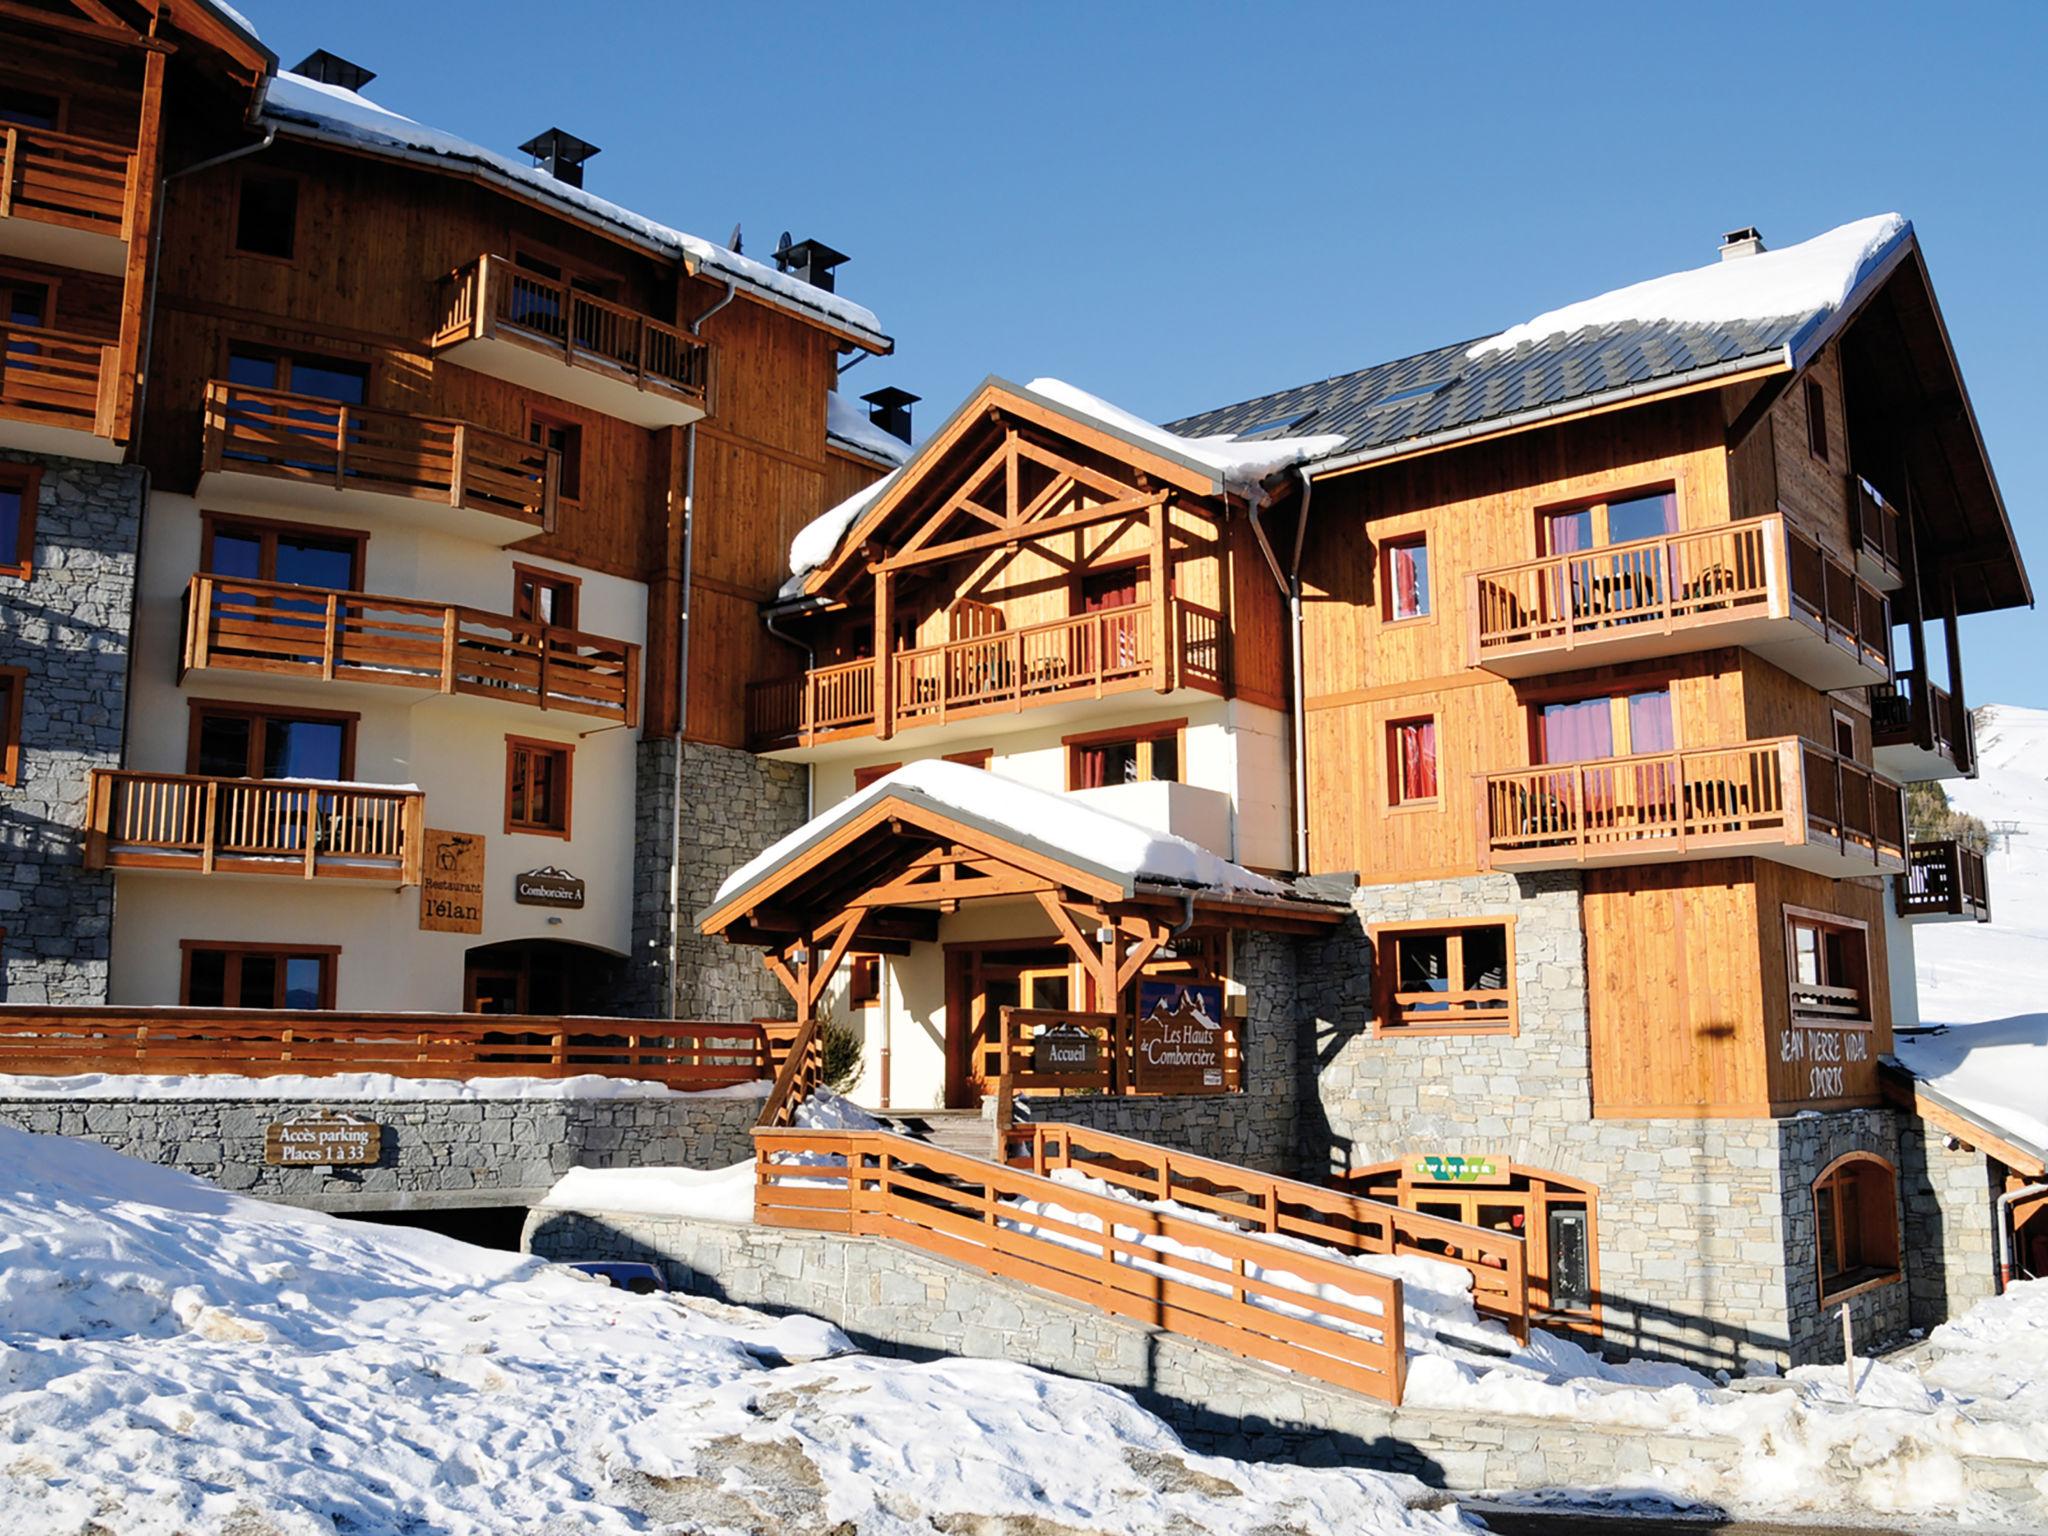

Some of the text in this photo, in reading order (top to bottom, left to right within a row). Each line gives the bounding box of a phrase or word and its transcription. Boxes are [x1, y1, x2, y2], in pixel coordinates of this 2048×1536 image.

[425, 877, 482, 894] Restaurant
[574, 888, 582, 900] A
[426, 899, 478, 920] l'élan
[1164, 1024, 1214, 1045] Les Hauts
[1049, 1043, 1086, 1062] Accueil
[1140, 1038, 1216, 1065] de Comborcière
[1781, 1029, 1868, 1062] JEAN PIERRE VIDAL
[1809, 1066, 1844, 1098] SPORTS
[279, 1127, 369, 1146] Accès parking
[282, 1145, 365, 1161] Places 1 à 33
[1416, 1163, 1492, 1175] TWINNER
